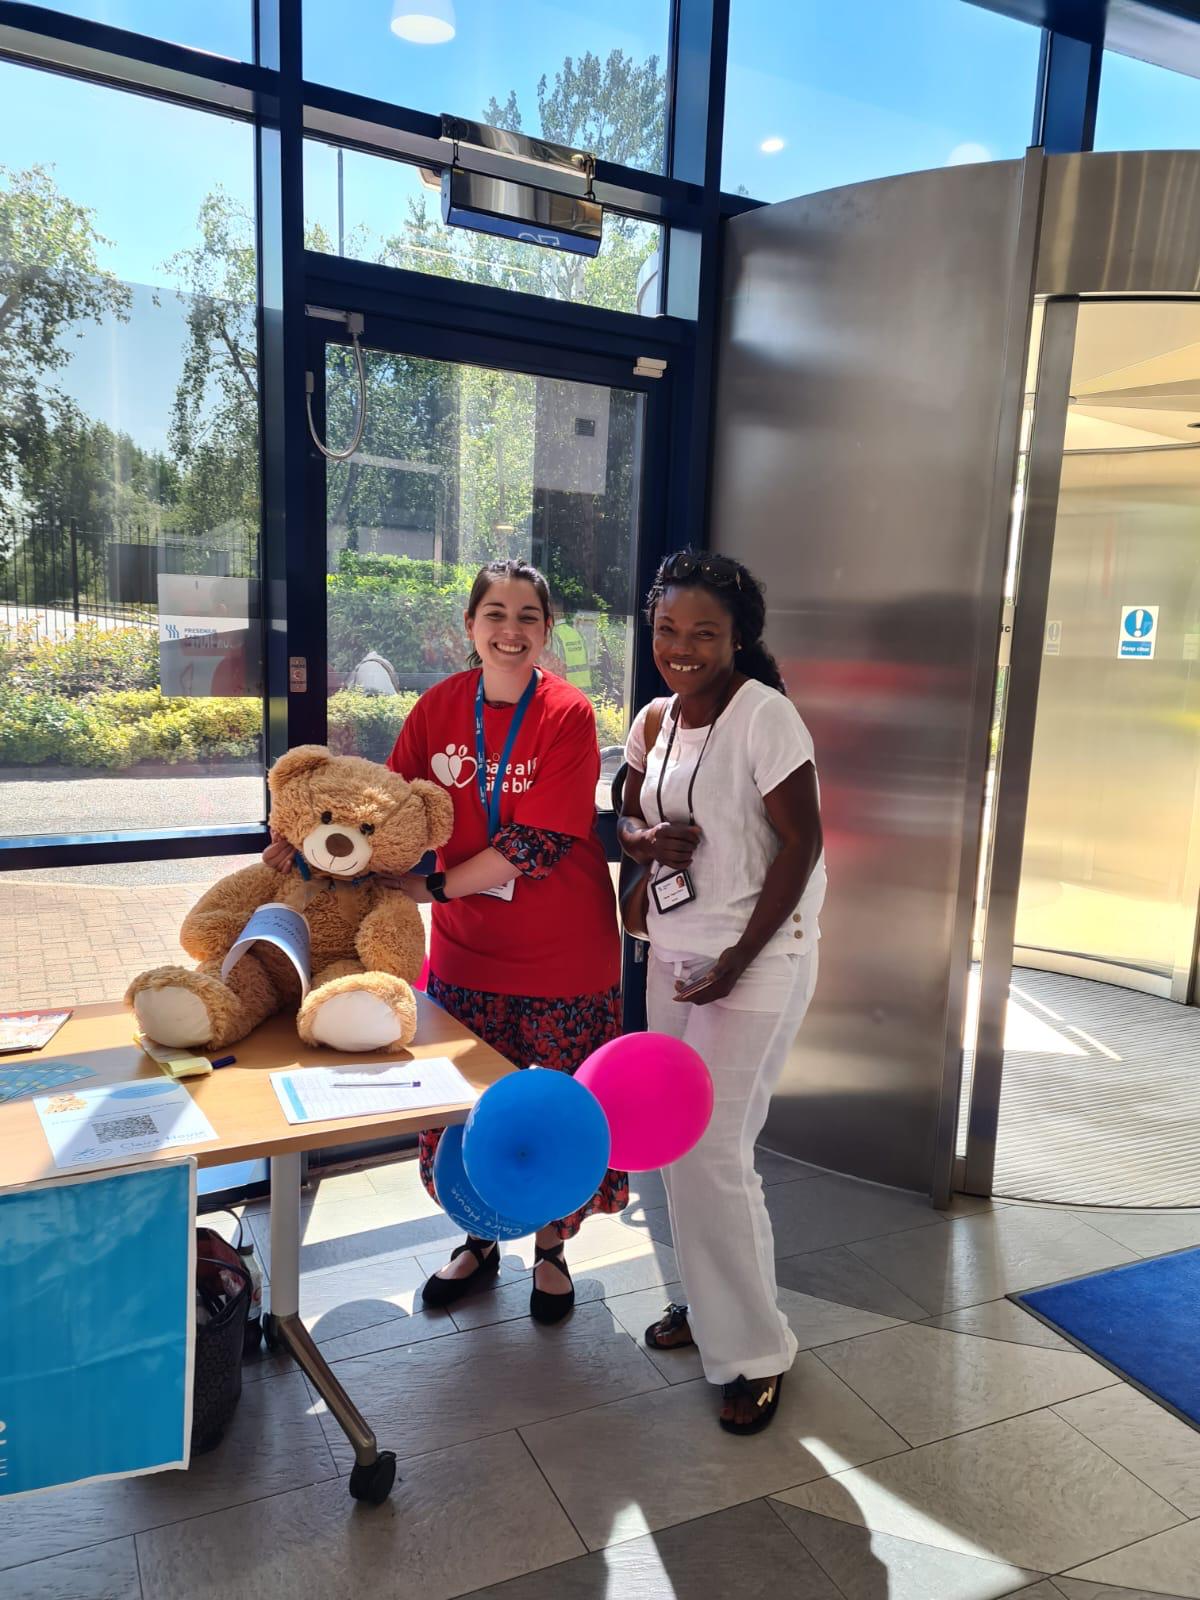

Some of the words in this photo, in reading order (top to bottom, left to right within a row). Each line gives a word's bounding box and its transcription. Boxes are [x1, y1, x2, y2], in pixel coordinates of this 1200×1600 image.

[514, 763, 525, 776] a
[450, 1186, 481, 1221] House
[484, 1219, 522, 1236] Claire
